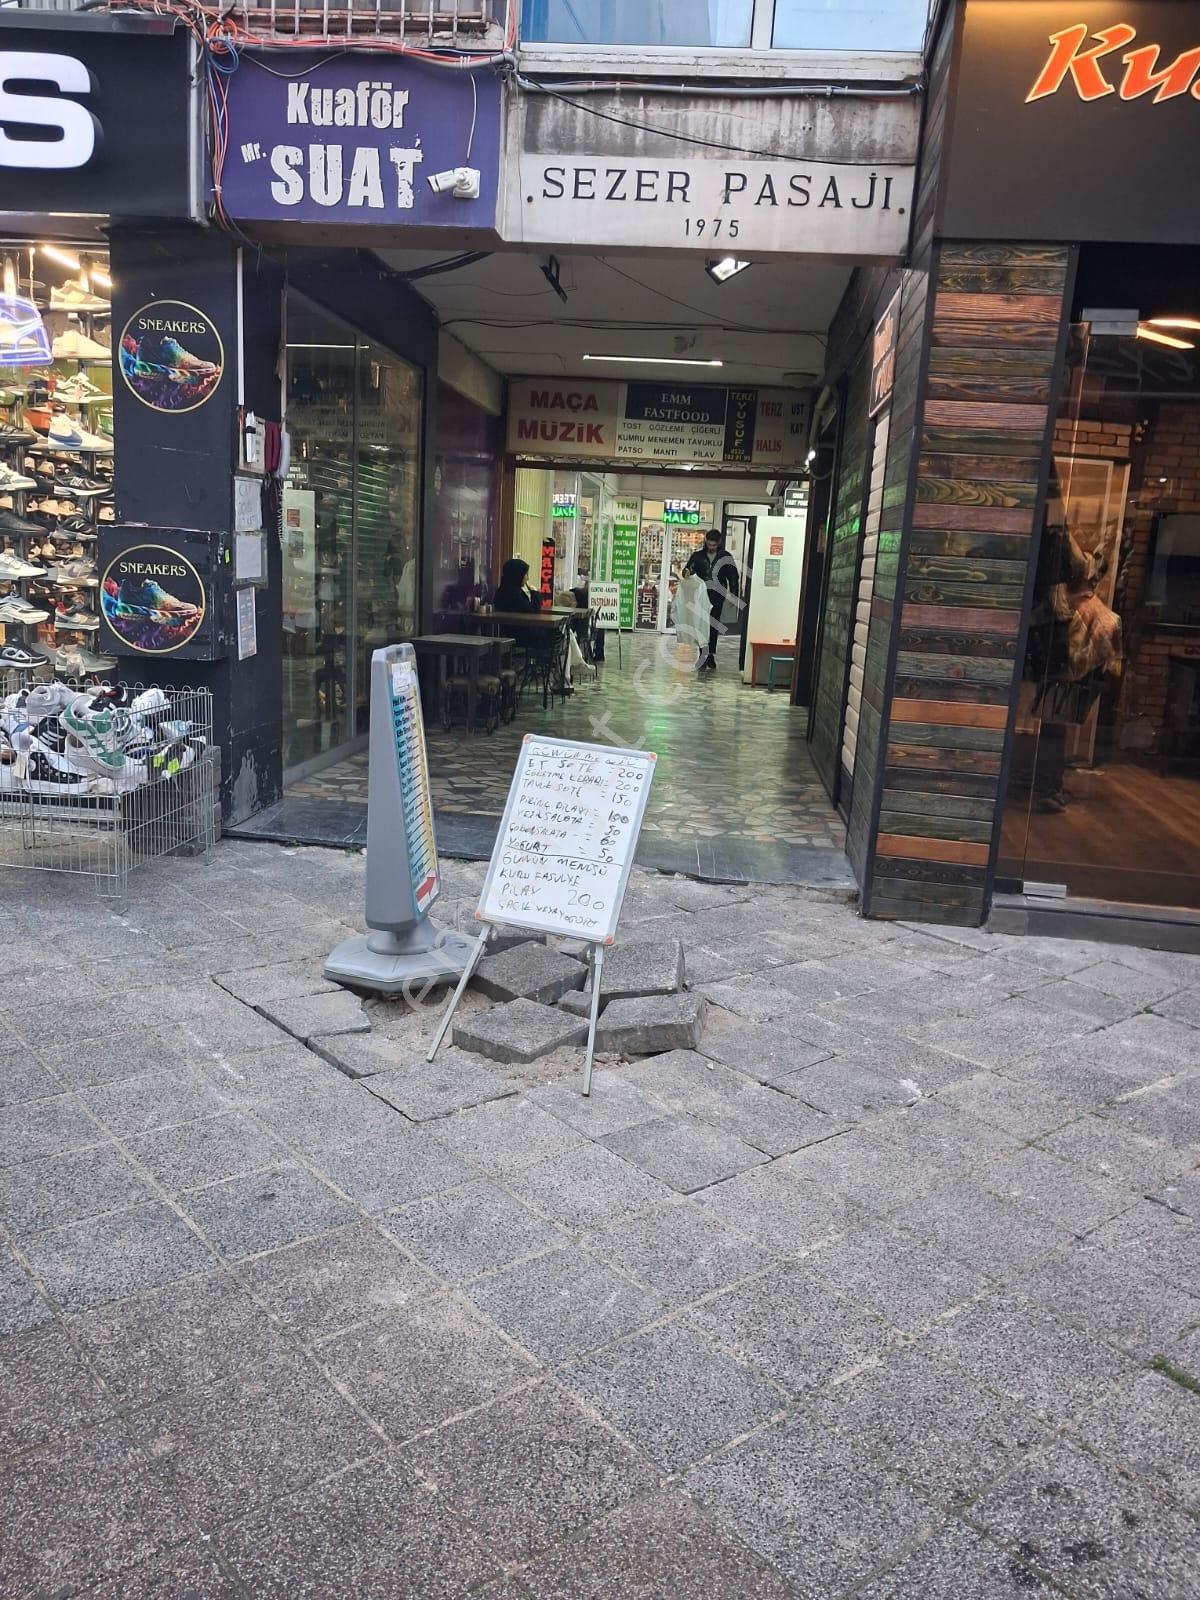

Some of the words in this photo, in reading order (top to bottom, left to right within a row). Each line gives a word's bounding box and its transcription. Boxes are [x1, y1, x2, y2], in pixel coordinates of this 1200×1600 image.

[1024, 23, 1200, 103] Ku
[287, 81, 409, 129] Kuaför
[241, 142, 267, 163] Mr.
[270, 144, 424, 208] SUAT
[542, 166, 691, 203] SEZER
[684, 218, 740, 239] 1975
[138, 318, 206, 334] SNEAKERS
[530, 390, 598, 413] MAÇA
[661, 393, 691, 405] EMM
[643, 407, 710, 422] FASTFOOD
[517, 418, 604, 444] MÜZİK
[623, 422, 641, 430] TOST
[617, 434, 645, 442] KUMRU
[647, 436, 685, 445] MENEMEN
[687, 438, 723, 447] TAVUKLU
[618, 446, 643, 454] PATSO
[653, 448, 677, 456] MANTI
[119, 561, 187, 577] SNEAKERS
[618, 768, 644, 780] 200
[616, 780, 639, 792] 200
[612, 792, 632, 807] 150
[599, 848, 613, 863] 50
[567, 889, 605, 910] 200
